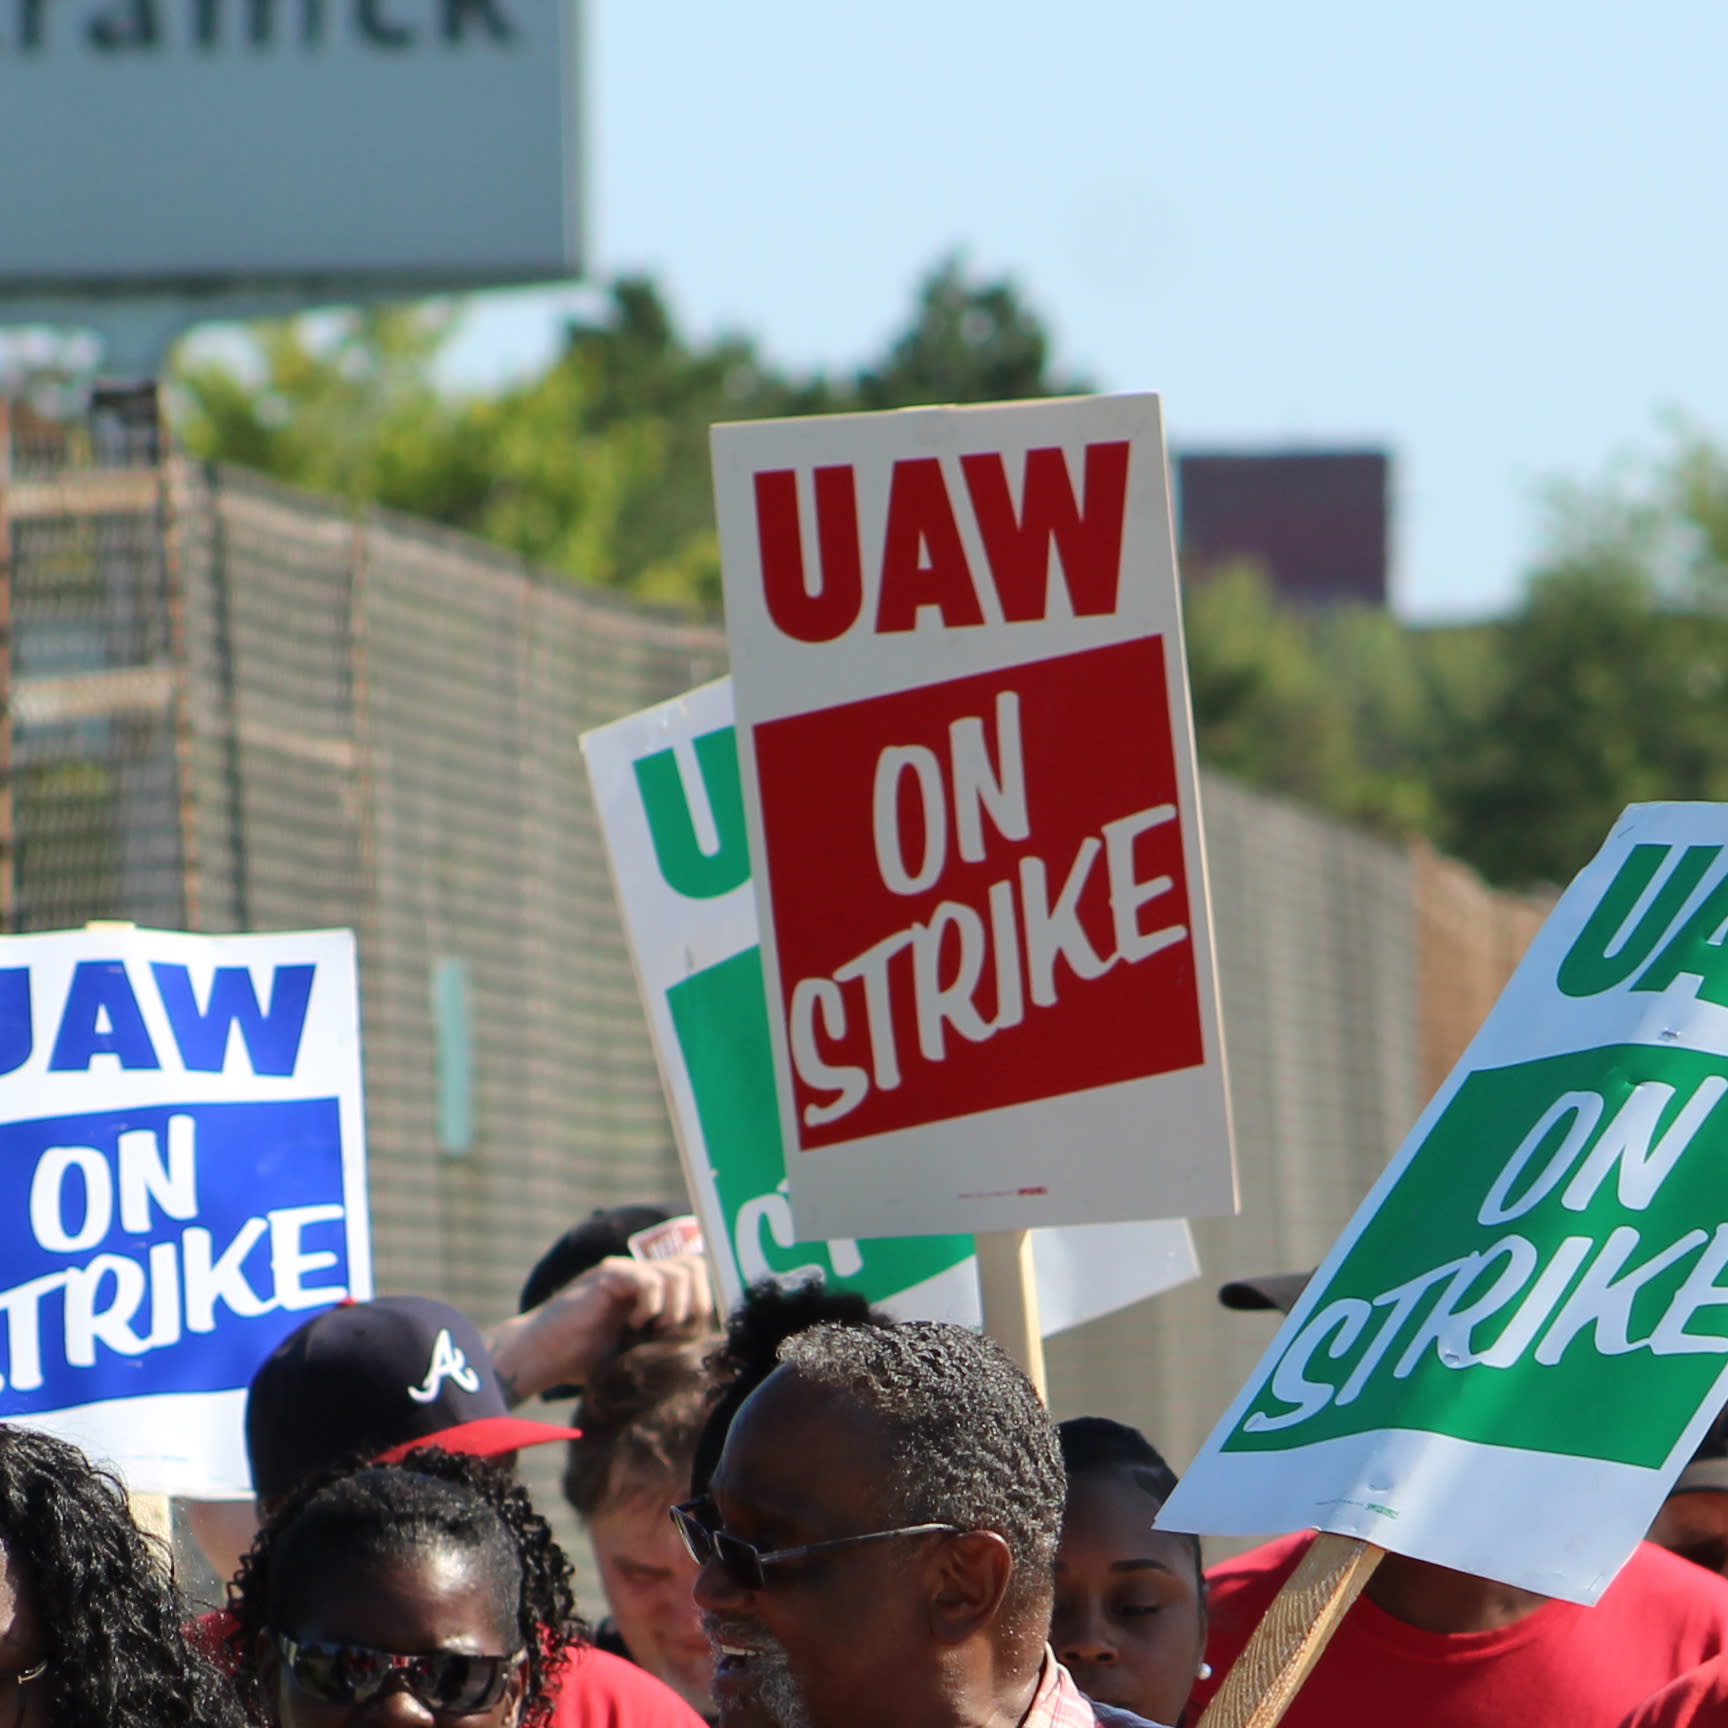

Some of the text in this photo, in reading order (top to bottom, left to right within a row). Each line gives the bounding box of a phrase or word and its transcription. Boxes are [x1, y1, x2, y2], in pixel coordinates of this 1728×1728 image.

[752, 440, 1130, 643] UAW
[872, 690, 1029, 896] ON
[789, 804, 1187, 1126] STRIKE
[30, 1114, 197, 1252] ON
[1477, 1075, 1728, 1226] ON
